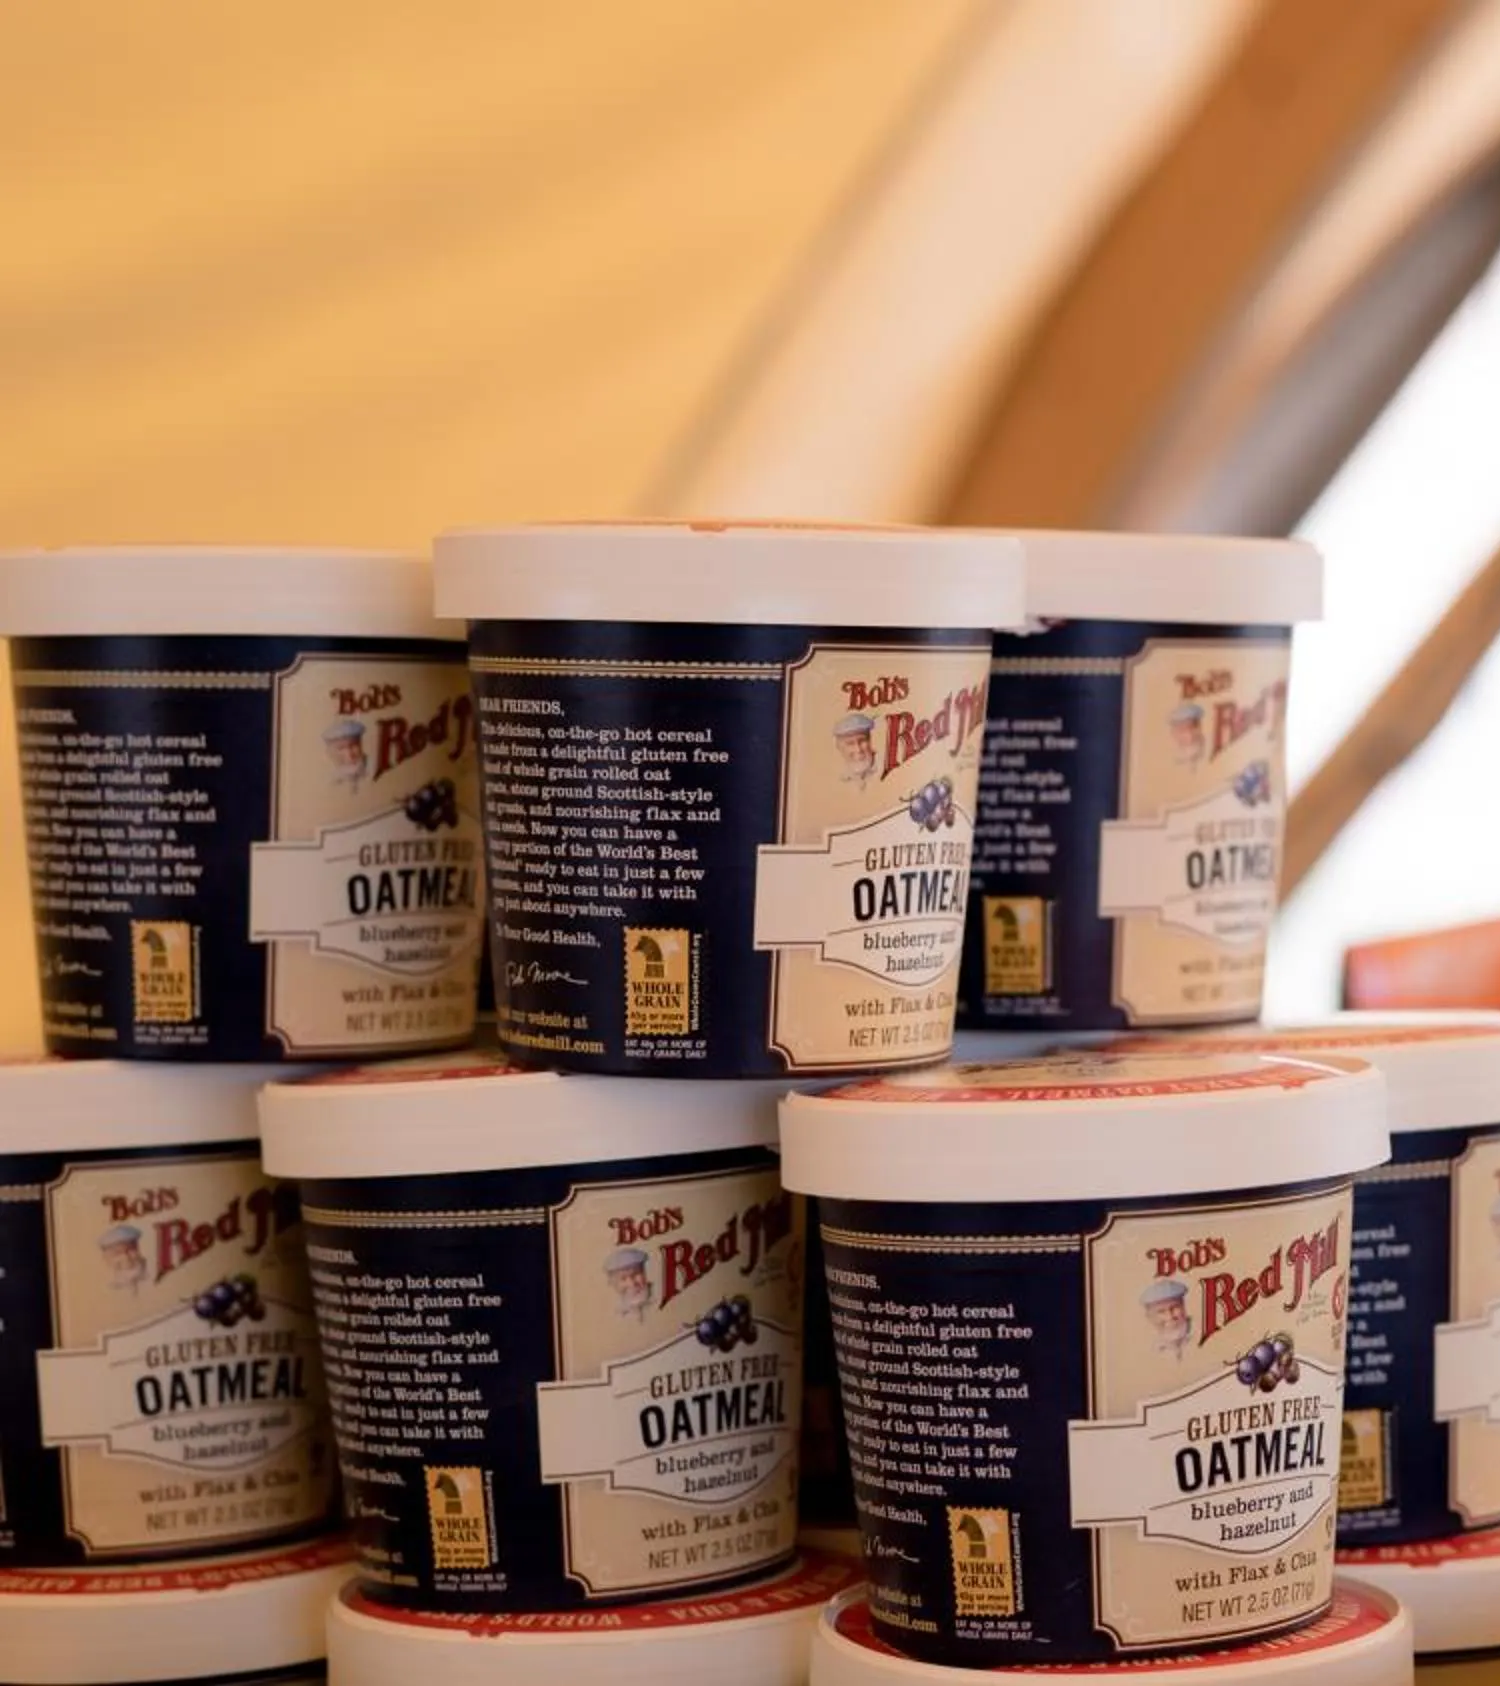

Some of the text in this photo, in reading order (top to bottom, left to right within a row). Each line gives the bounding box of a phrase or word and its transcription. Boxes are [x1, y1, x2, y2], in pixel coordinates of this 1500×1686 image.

[841, 675, 909, 710] Bob's
[373, 697, 449, 783] Red
[548, 727, 712, 744] on-the-go hot cereal
[880, 690, 952, 781] Red
[551, 747, 627, 762] delightful
[631, 750, 687, 764] gluten
[693, 749, 729, 763] free
[548, 766, 671, 780] grain rolled oat
[542, 786, 713, 804] ground Scottish-style
[530, 804, 721, 823] and nourishing flax and
[531, 822, 678, 840] Now you can have a
[554, 844, 698, 860] of the World's Best
[865, 842, 938, 872] GLUTEN
[561, 864, 574, 875] to
[578, 865, 600, 877] eat
[603, 865, 619, 877] in
[624, 865, 656, 880] just
[660, 869, 669, 879] a
[674, 866, 705, 880] few
[524, 880, 697, 899] and you can take it with
[554, 902, 626, 917] anywhere.
[553, 930, 600, 947] Health,
[863, 928, 937, 950] blueberry
[632, 982, 684, 995] WHOLE
[635, 996, 680, 1009] GRAIN
[844, 997, 921, 1017] with Flax
[849, 1026, 899, 1047] NET WT
[608, 1207, 683, 1246] Bob's
[155, 1196, 243, 1284] Red
[659, 1212, 740, 1310] Red
[1146, 1237, 1226, 1278] Bob's
[405, 1274, 484, 1289] hot cereal
[1198, 1216, 1339, 1346] Red Mill
[413, 1295, 501, 1311] gluten free
[868, 1300, 928, 1320] on-the-go
[932, 1303, 958, 1319] hot
[962, 1303, 1015, 1319] cereal
[426, 1315, 451, 1326] oat
[872, 1320, 1033, 1340] delightful gluten free
[146, 1333, 238, 1369] GLUTEN
[432, 1350, 500, 1364] flax and
[872, 1338, 978, 1358] grain rolled oat
[414, 1370, 462, 1383] have a
[650, 1360, 734, 1400] GLUTEN
[868, 1360, 1020, 1381] ground Scottish-style
[135, 1357, 308, 1416] OATMEAL
[448, 1388, 482, 1401] Best
[881, 1382, 1029, 1400] nourishing flax and
[417, 1407, 445, 1423] just
[462, 1408, 490, 1420] few
[640, 1380, 787, 1448] OATMEAL
[887, 1401, 988, 1418] you can have a
[1187, 1396, 1321, 1442] GLUTEN FREE
[450, 1426, 485, 1439] with
[894, 1419, 914, 1434] the
[916, 1422, 969, 1438] World's
[973, 1424, 1011, 1438] Best
[889, 1438, 1017, 1460] to eat in just a few
[1175, 1422, 1325, 1492] OATMEAL
[656, 1451, 744, 1475] blueberry
[901, 1461, 921, 1474] can
[925, 1462, 955, 1477] take
[959, 1463, 971, 1478] it
[975, 1464, 1012, 1479] with
[684, 1466, 758, 1494] hazelnut
[1191, 1482, 1314, 1521] blueberry and
[641, 1514, 732, 1541] with Flax
[1219, 1513, 1296, 1540] hazelnut
[649, 1549, 678, 1569] NET
[684, 1545, 706, 1565] WT
[959, 1562, 1007, 1575] WHOLE
[1175, 1551, 1317, 1592] with Flax & Chia
[962, 1576, 1004, 1588] GRAIN
[1182, 1586, 1289, 1623] NET WT 2.5 OZ
